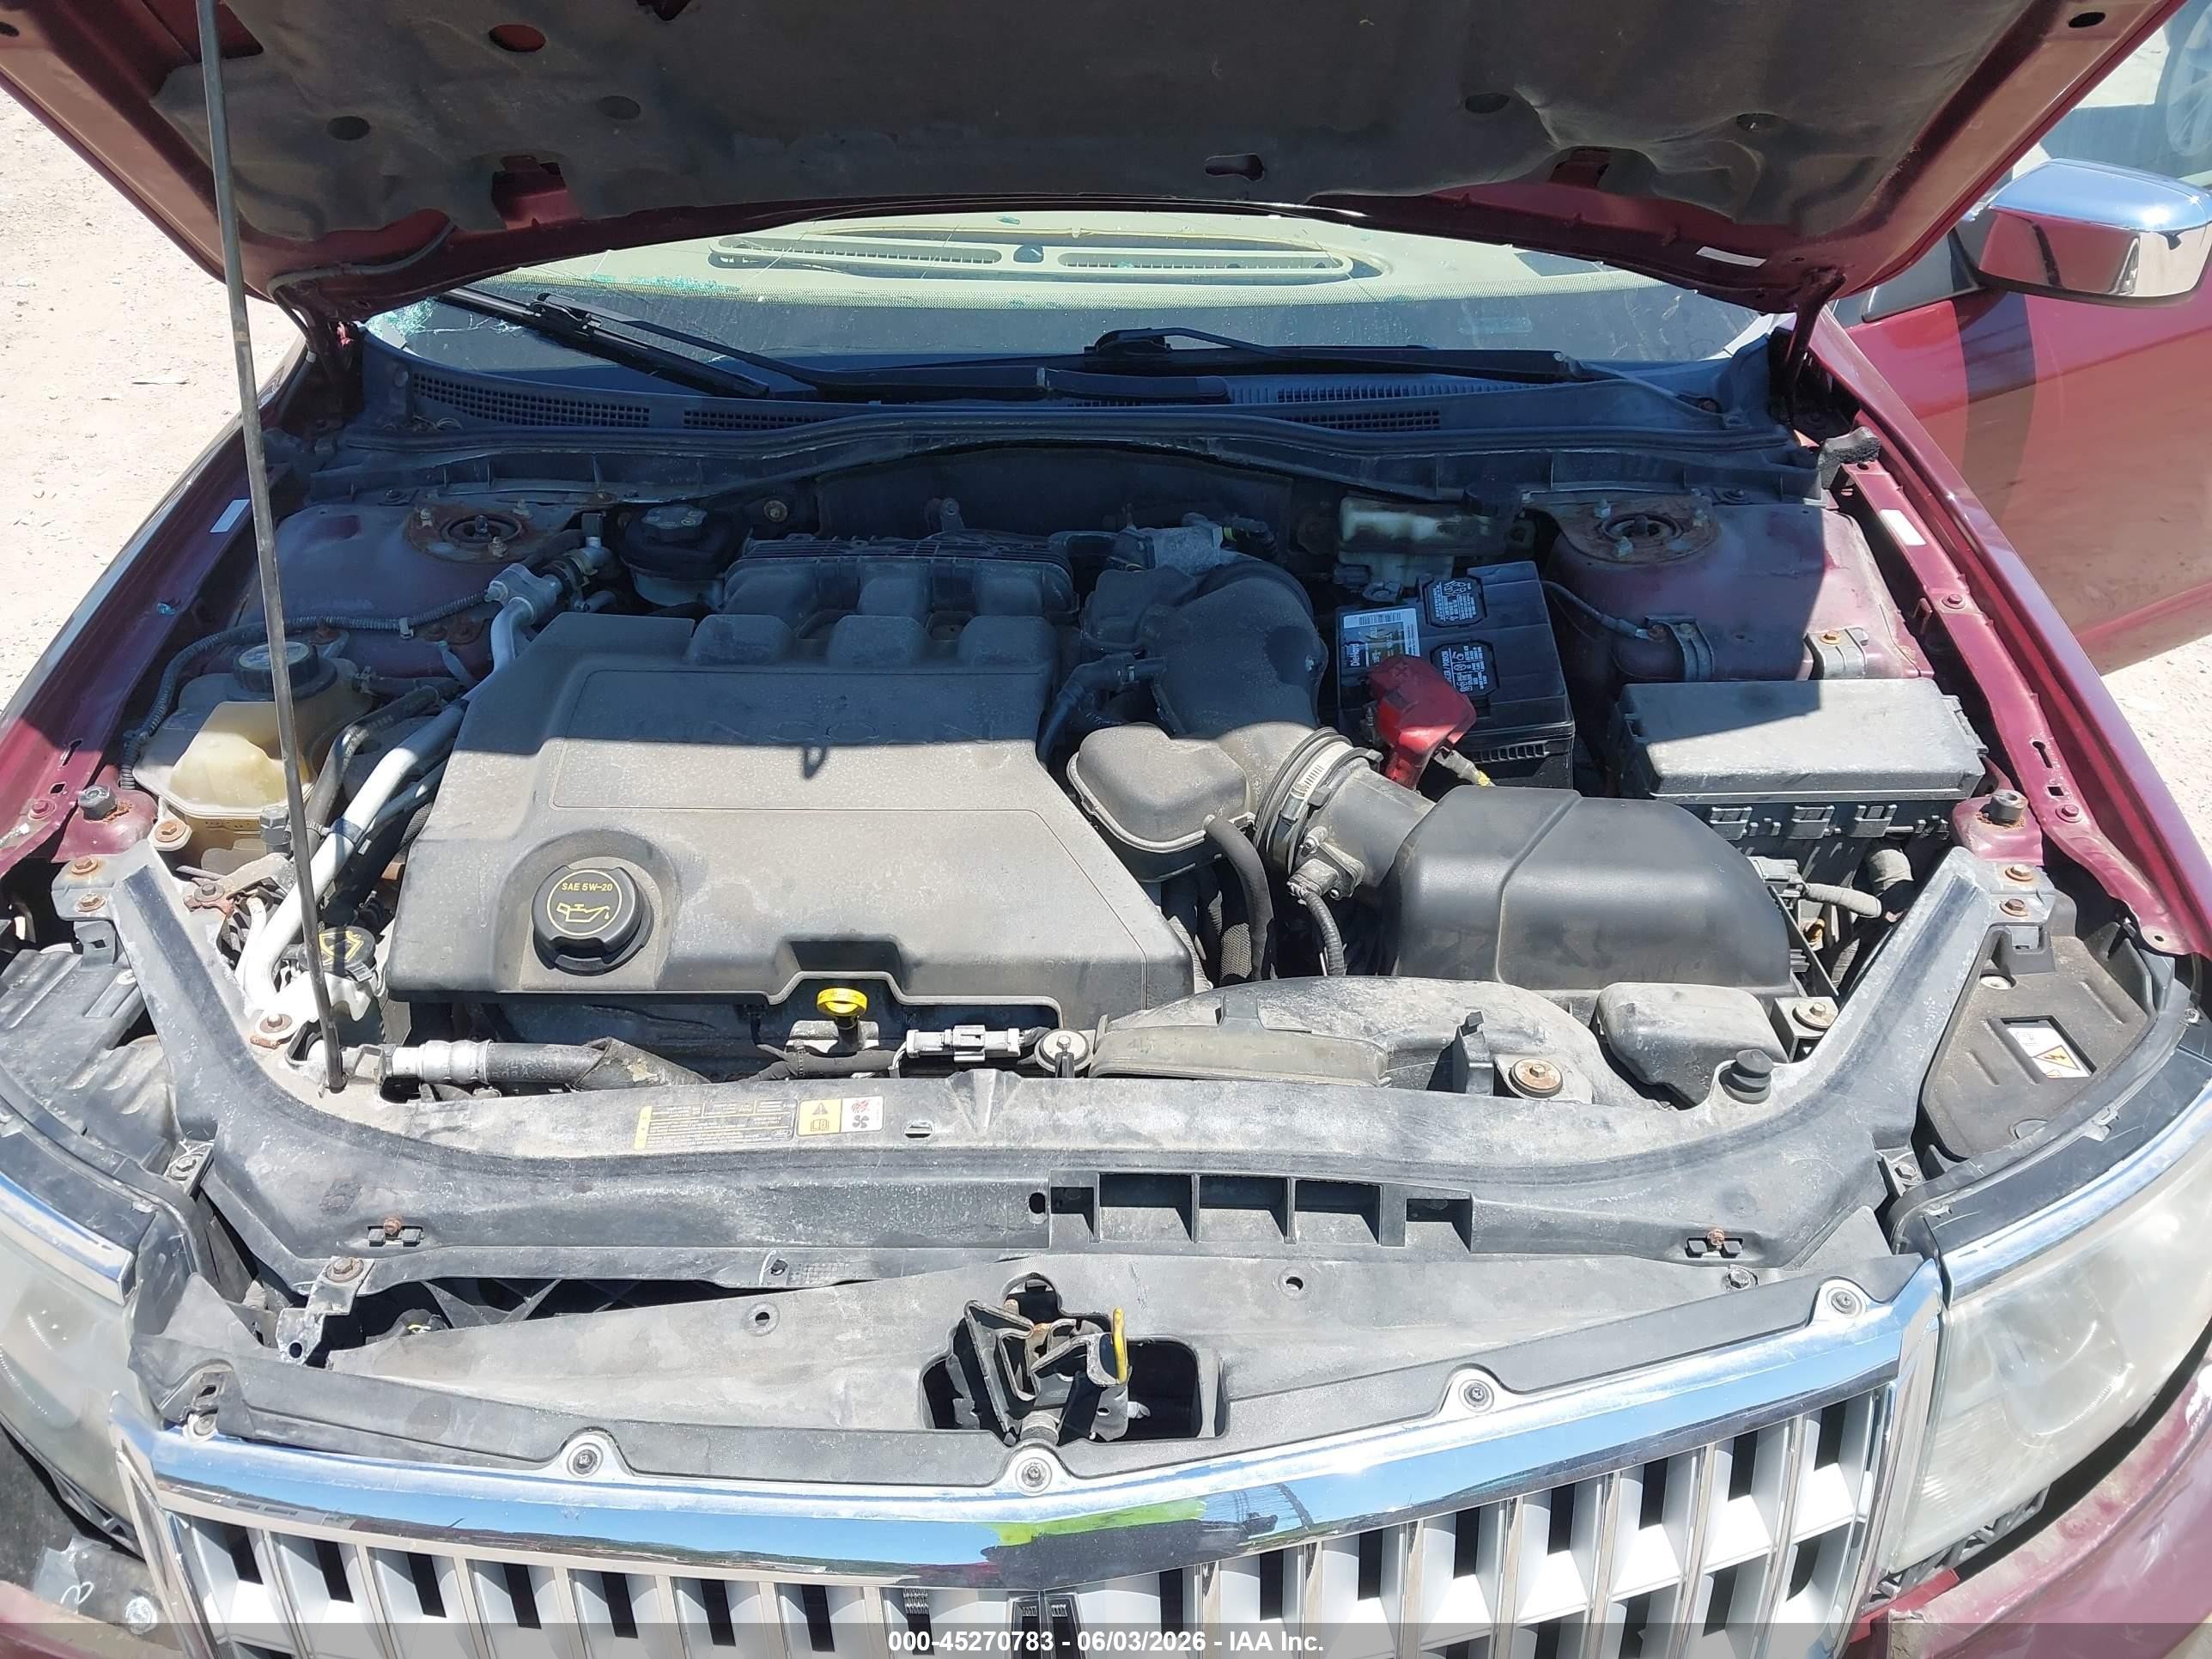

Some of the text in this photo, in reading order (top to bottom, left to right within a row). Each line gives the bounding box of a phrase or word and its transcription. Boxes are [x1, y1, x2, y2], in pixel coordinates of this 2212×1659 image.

[1350, 643, 1360, 666] DieHard
[561, 882, 613, 891] SAE 5W-20
